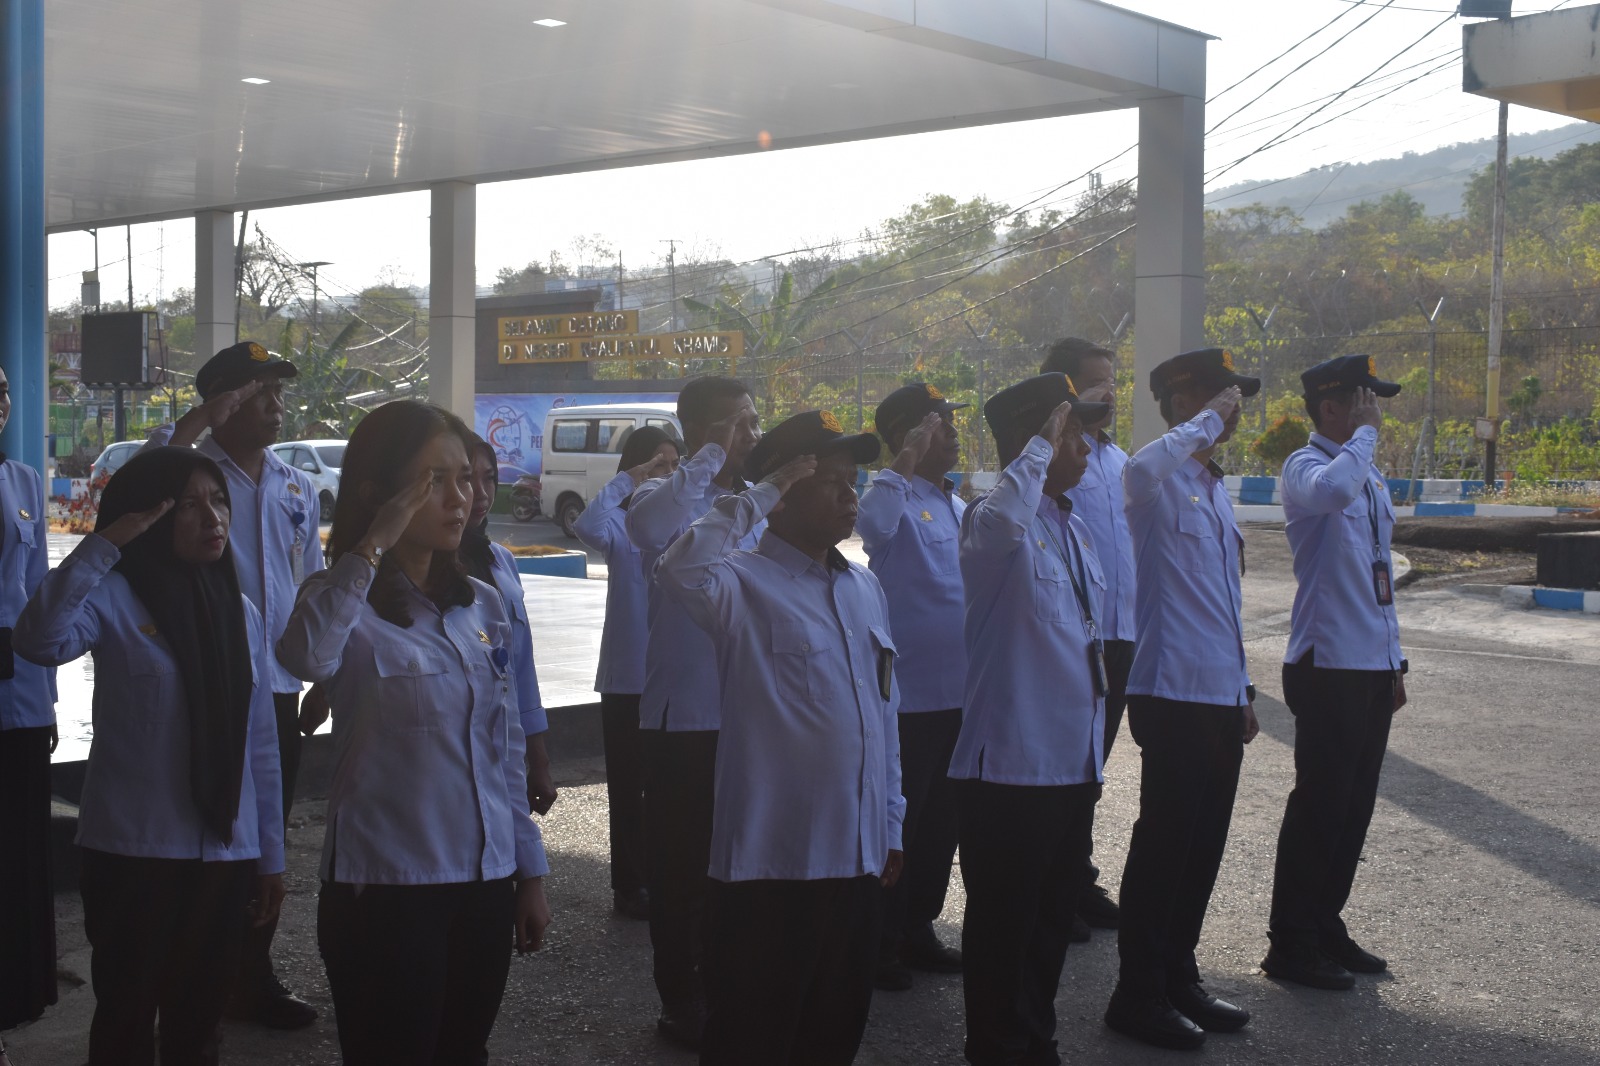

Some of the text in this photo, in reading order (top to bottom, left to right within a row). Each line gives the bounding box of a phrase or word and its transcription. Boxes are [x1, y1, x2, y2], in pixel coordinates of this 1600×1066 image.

[505, 314, 625, 337] SELAMAT DATANG
[673, 335, 730, 353] KHAMIS
